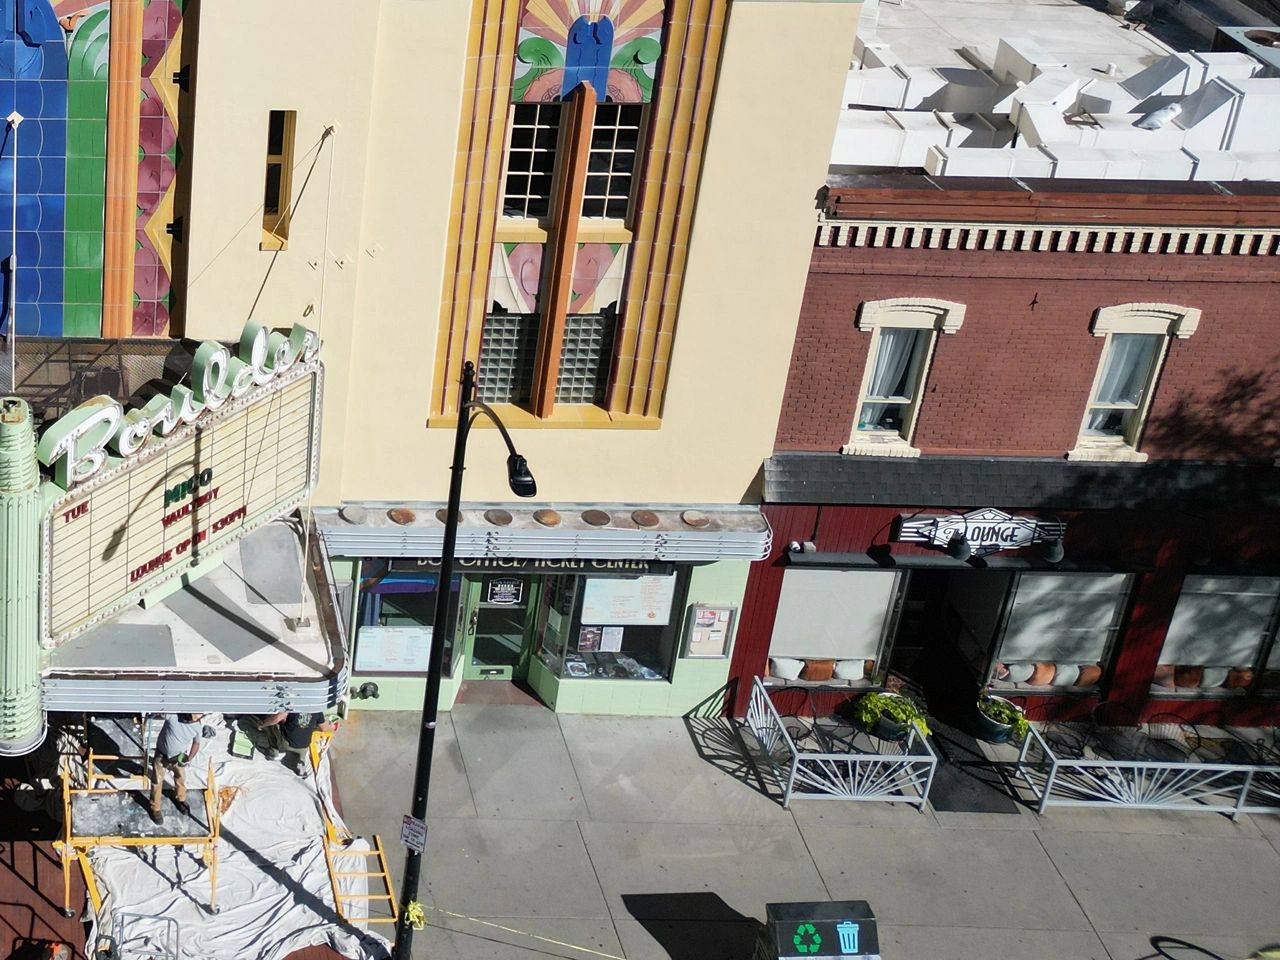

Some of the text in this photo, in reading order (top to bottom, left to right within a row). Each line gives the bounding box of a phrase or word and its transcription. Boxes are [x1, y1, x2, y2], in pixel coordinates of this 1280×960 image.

[37, 320, 318, 492] Boulder
[161, 486, 220, 527] VAULTBOY
[164, 468, 212, 509] MICO
[63, 500, 90, 523] TUE
[967, 526, 1021, 543] OUNGE
[130, 549, 173, 582] LOUNGE
[176, 529, 207, 555] OPEN
